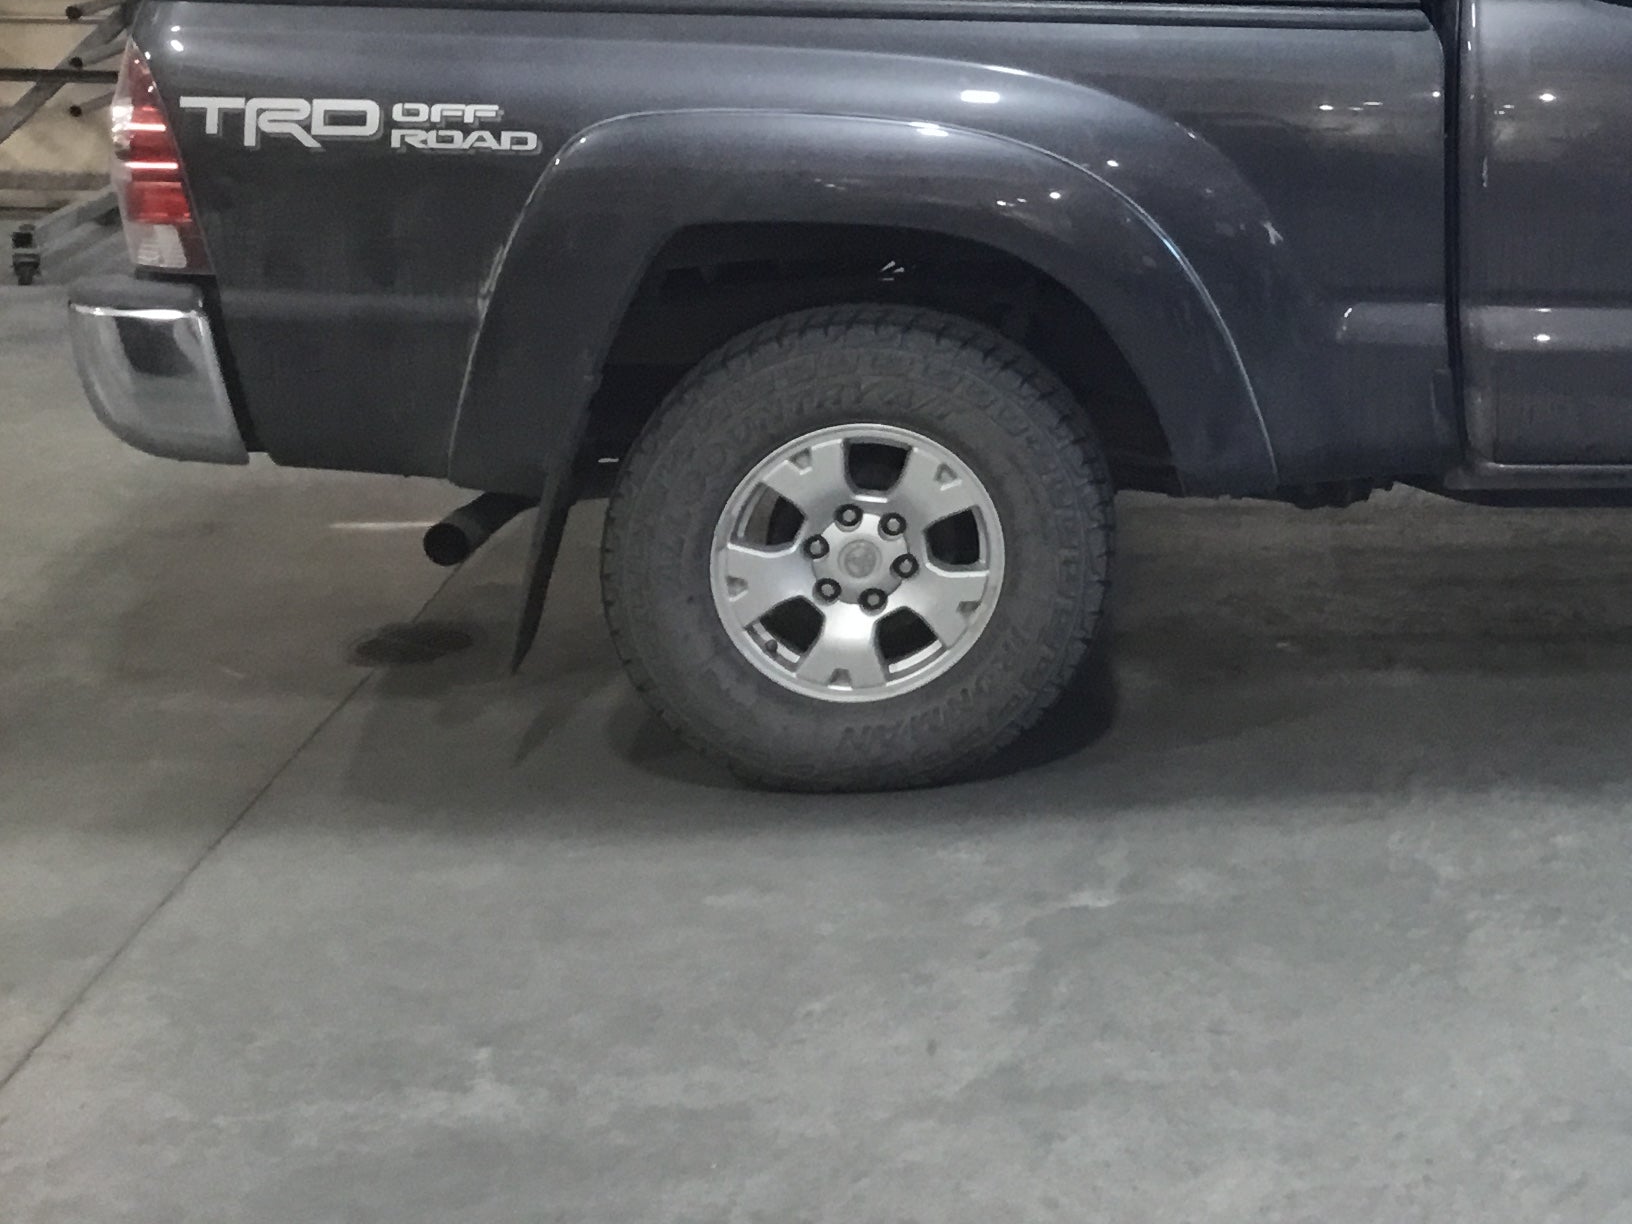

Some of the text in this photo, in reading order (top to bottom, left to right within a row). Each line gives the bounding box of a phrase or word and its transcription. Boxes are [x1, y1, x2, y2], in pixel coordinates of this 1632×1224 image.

[180, 95, 381, 148] TRD
[391, 102, 502, 123] OFF
[390, 128, 538, 152] ROAD
